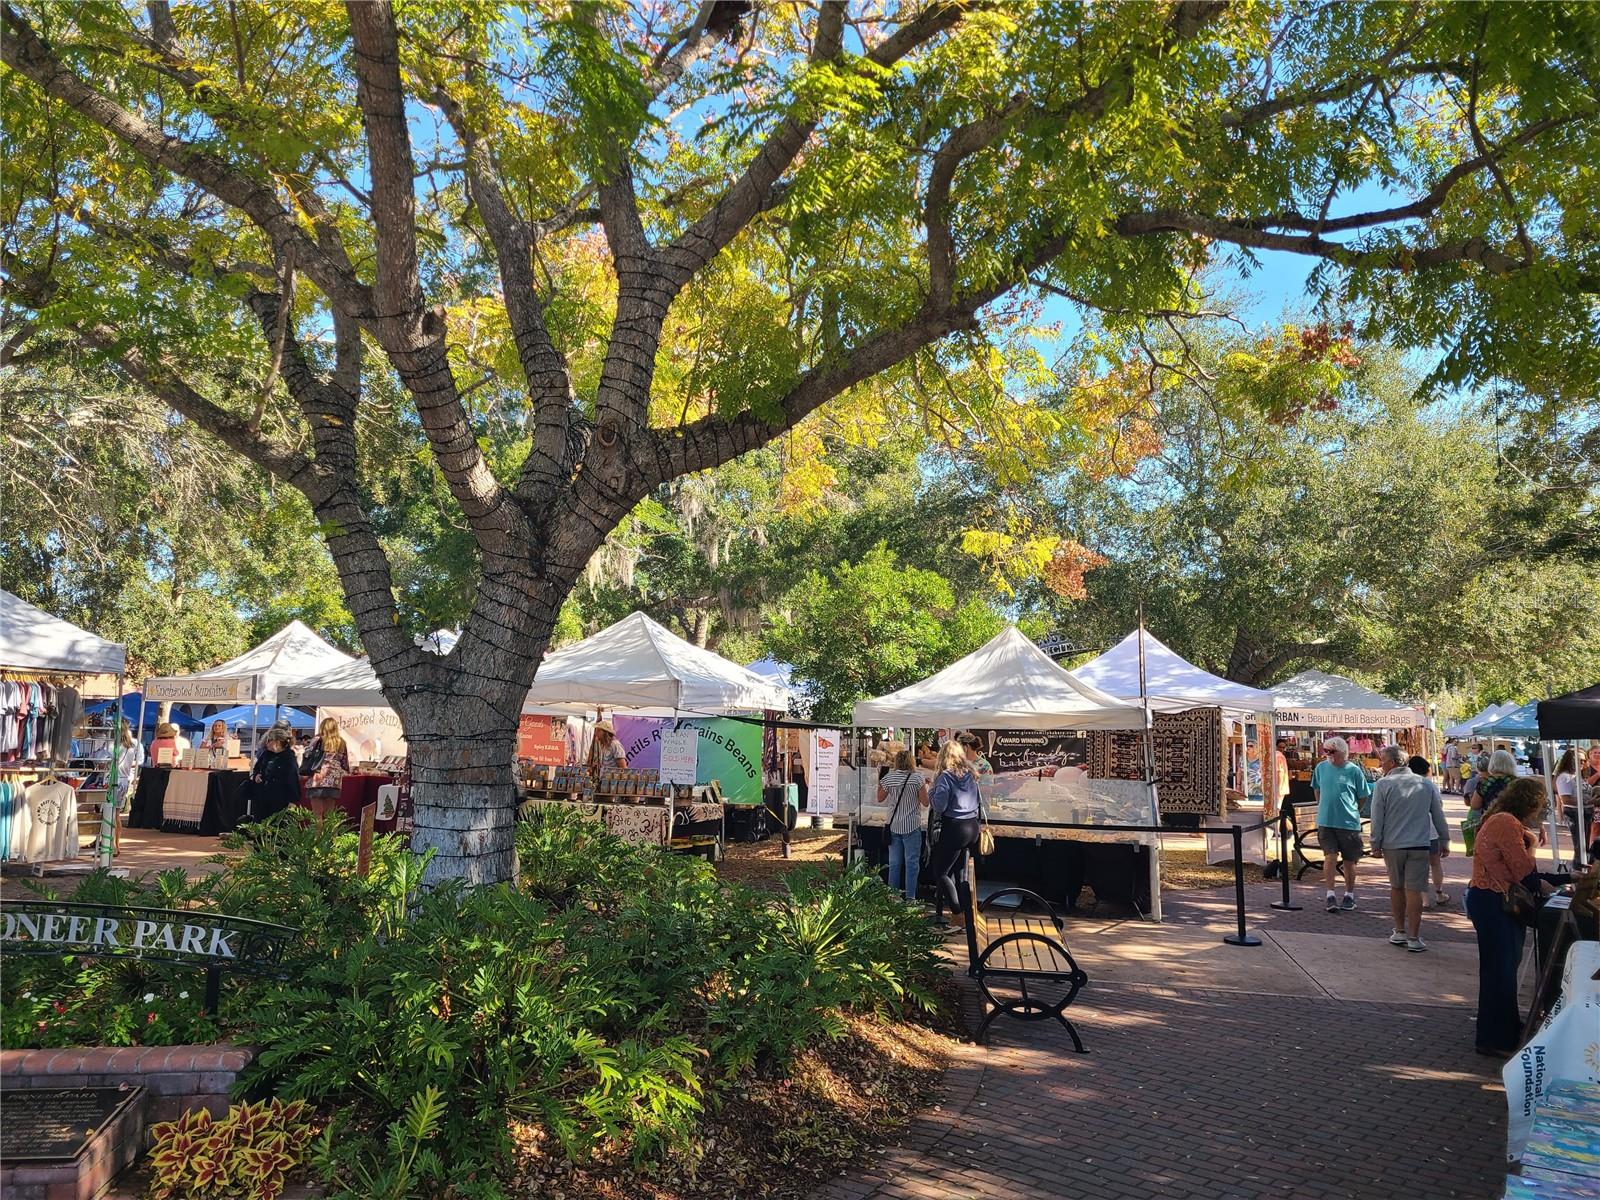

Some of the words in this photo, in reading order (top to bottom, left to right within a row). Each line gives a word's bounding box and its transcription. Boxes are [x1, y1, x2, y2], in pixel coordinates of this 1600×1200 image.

[155, 683, 192, 697] Enchanted
[195, 682, 228, 697] Sunshine
[1276, 711, 1299, 722] RBAN
[1307, 712, 1342, 724] Beautiful
[1345, 713, 1358, 724] Bali
[1360, 713, 1388, 725] Basket
[1390, 714, 1411, 726] Bags
[1021, 737, 1045, 745] WINNING
[724, 737, 757, 779] Beans
[999, 758, 1051, 767] bakery
[1023, 744, 1069, 765] family
[131, 920, 240, 957] PARK
[1521, 1046, 1534, 1117] Foundation
[1533, 1045, 1546, 1098] National
